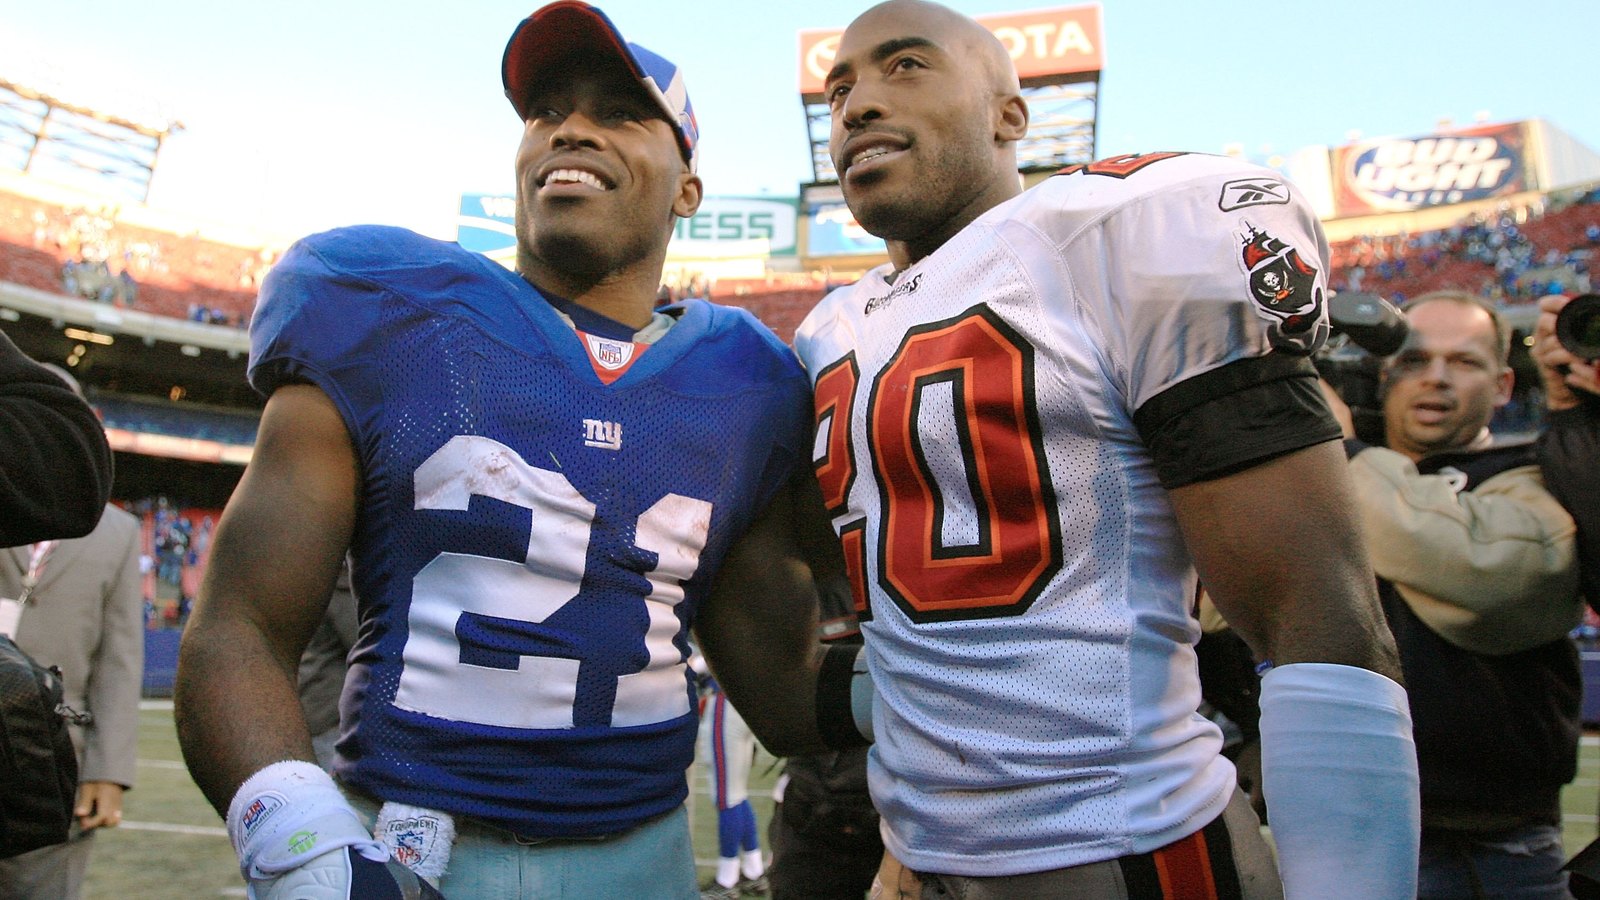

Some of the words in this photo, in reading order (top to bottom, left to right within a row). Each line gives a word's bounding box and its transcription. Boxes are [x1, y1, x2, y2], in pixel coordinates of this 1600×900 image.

[993, 21, 1094, 60] OTA
[1374, 137, 1498, 167] BUD
[1353, 158, 1512, 191] LIGHT
[601, 350, 620, 363] NFL
[391, 435, 713, 729] 21
[389, 819, 434, 832] EQUIPMENT
